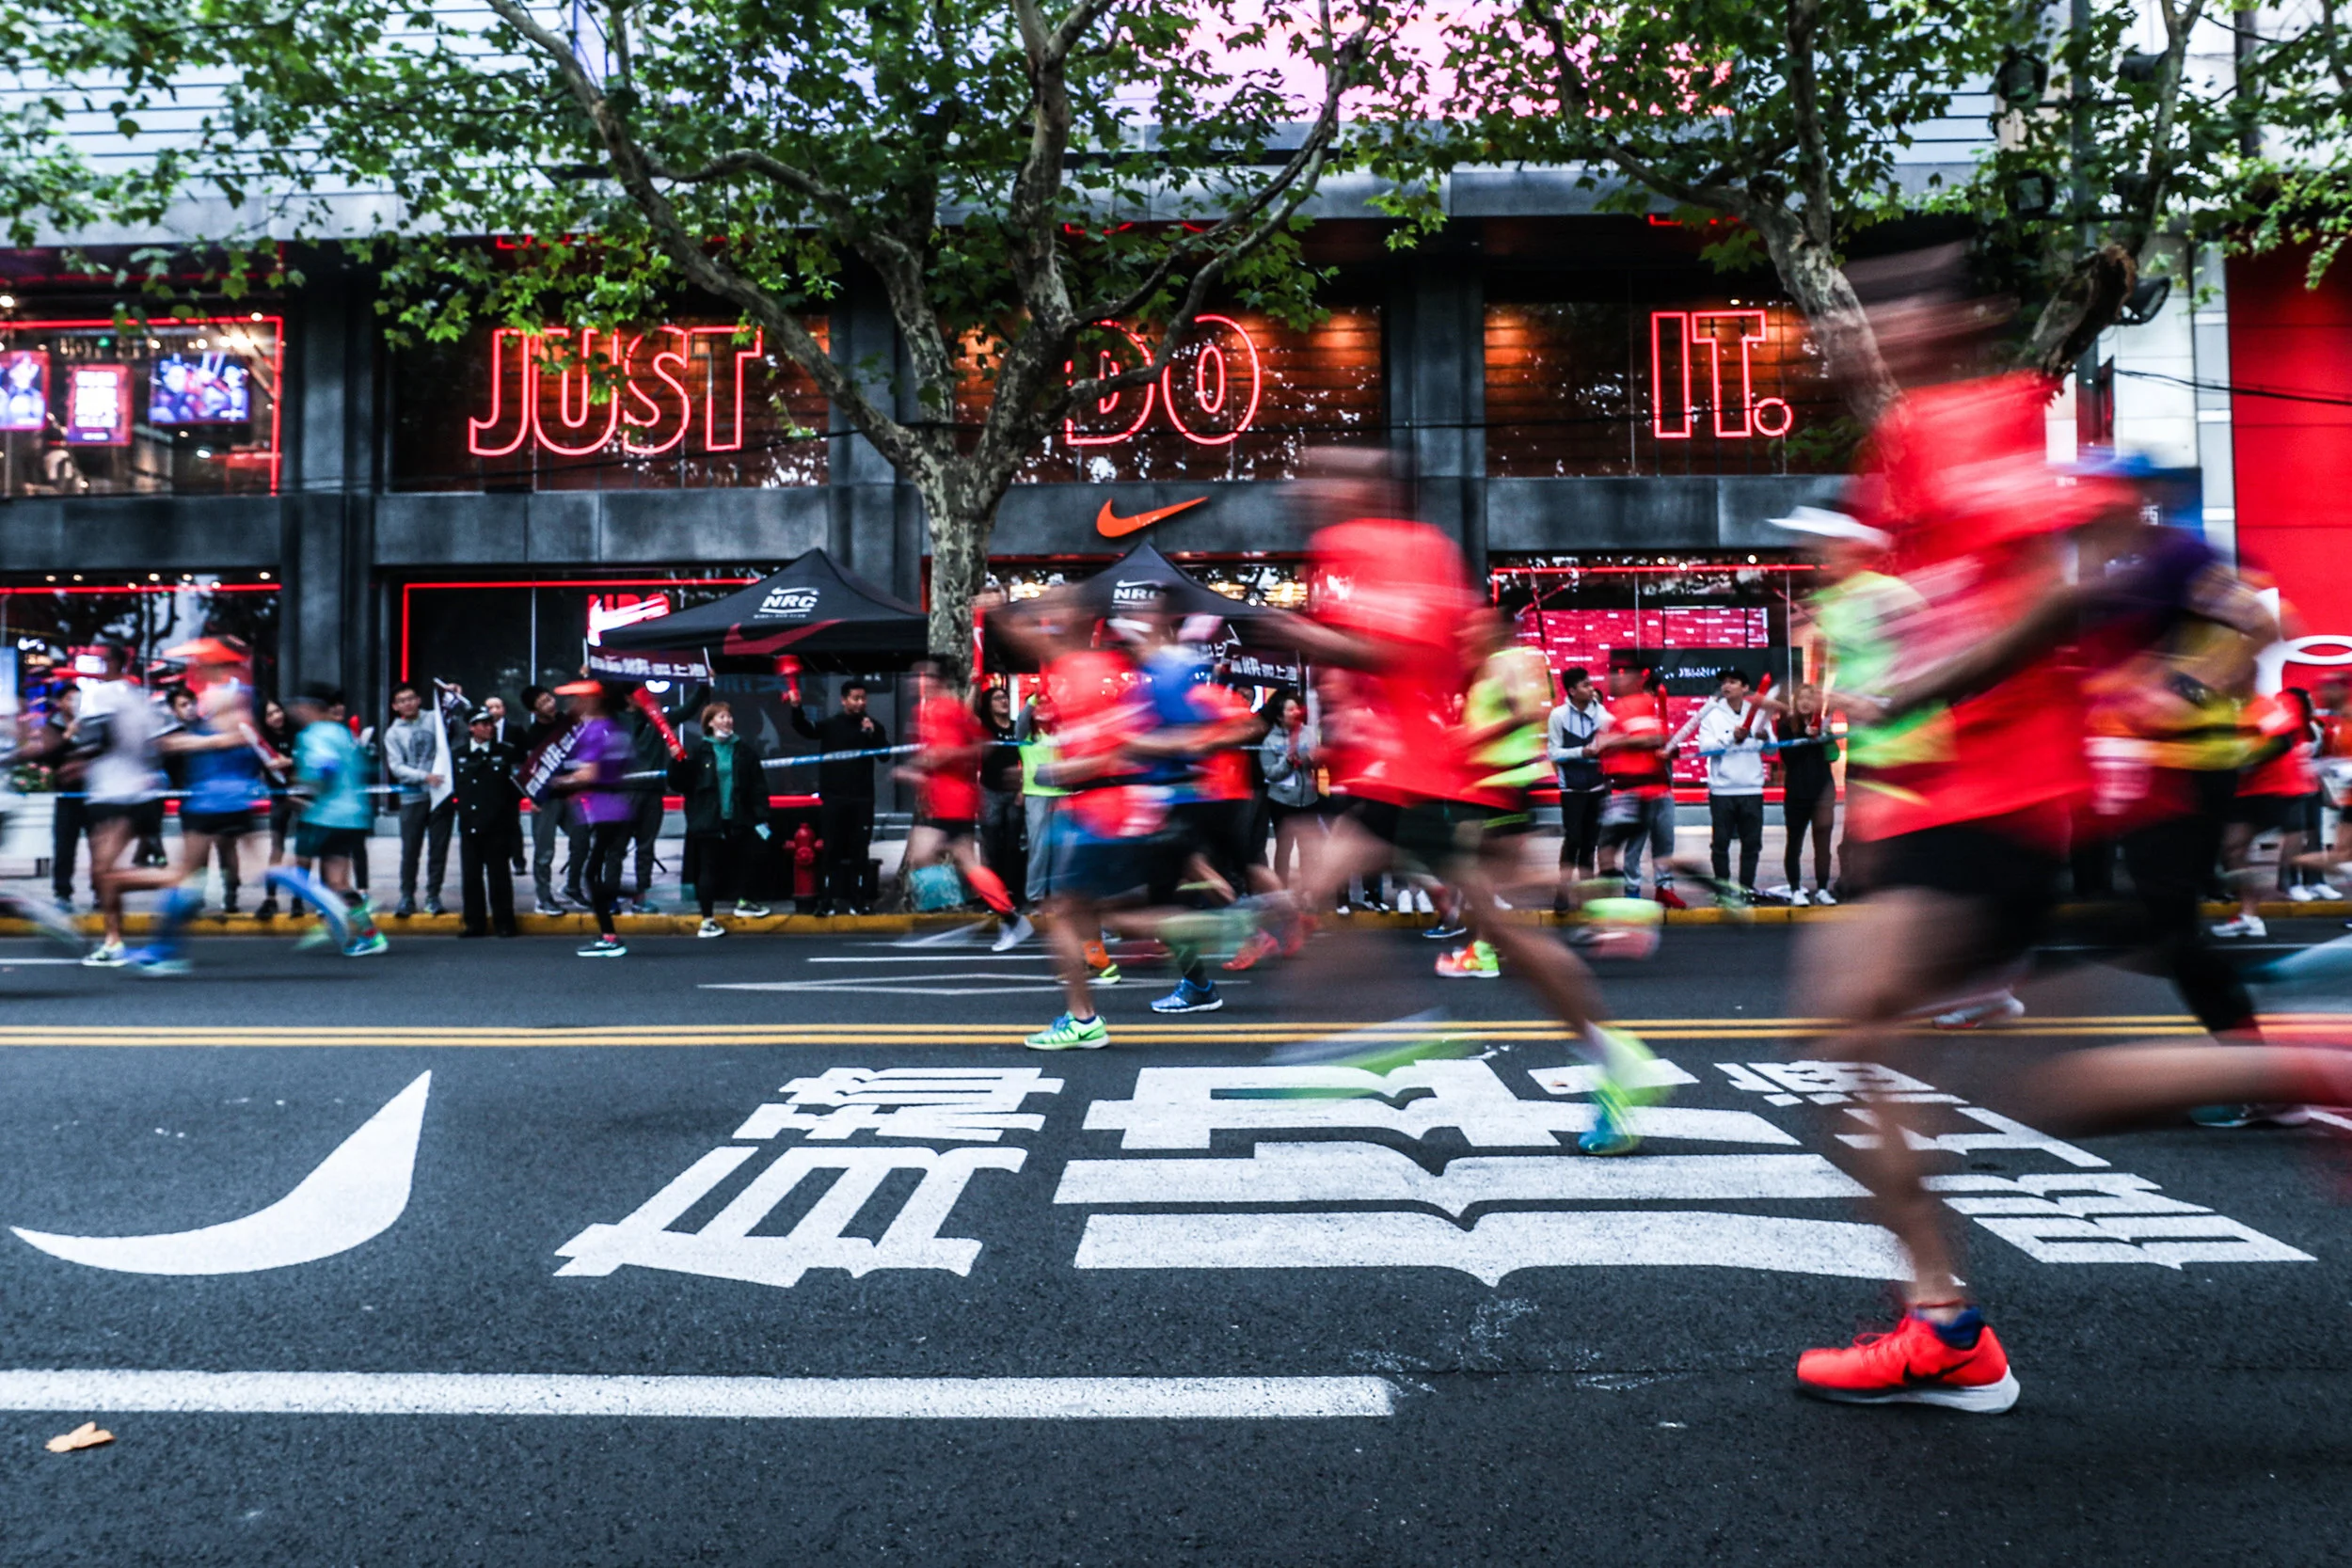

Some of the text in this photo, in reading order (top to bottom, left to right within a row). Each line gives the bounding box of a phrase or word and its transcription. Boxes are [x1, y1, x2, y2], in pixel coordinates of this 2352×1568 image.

[469, 309, 1794, 456] JUST DO IT.
[761, 594, 818, 609] NRC
